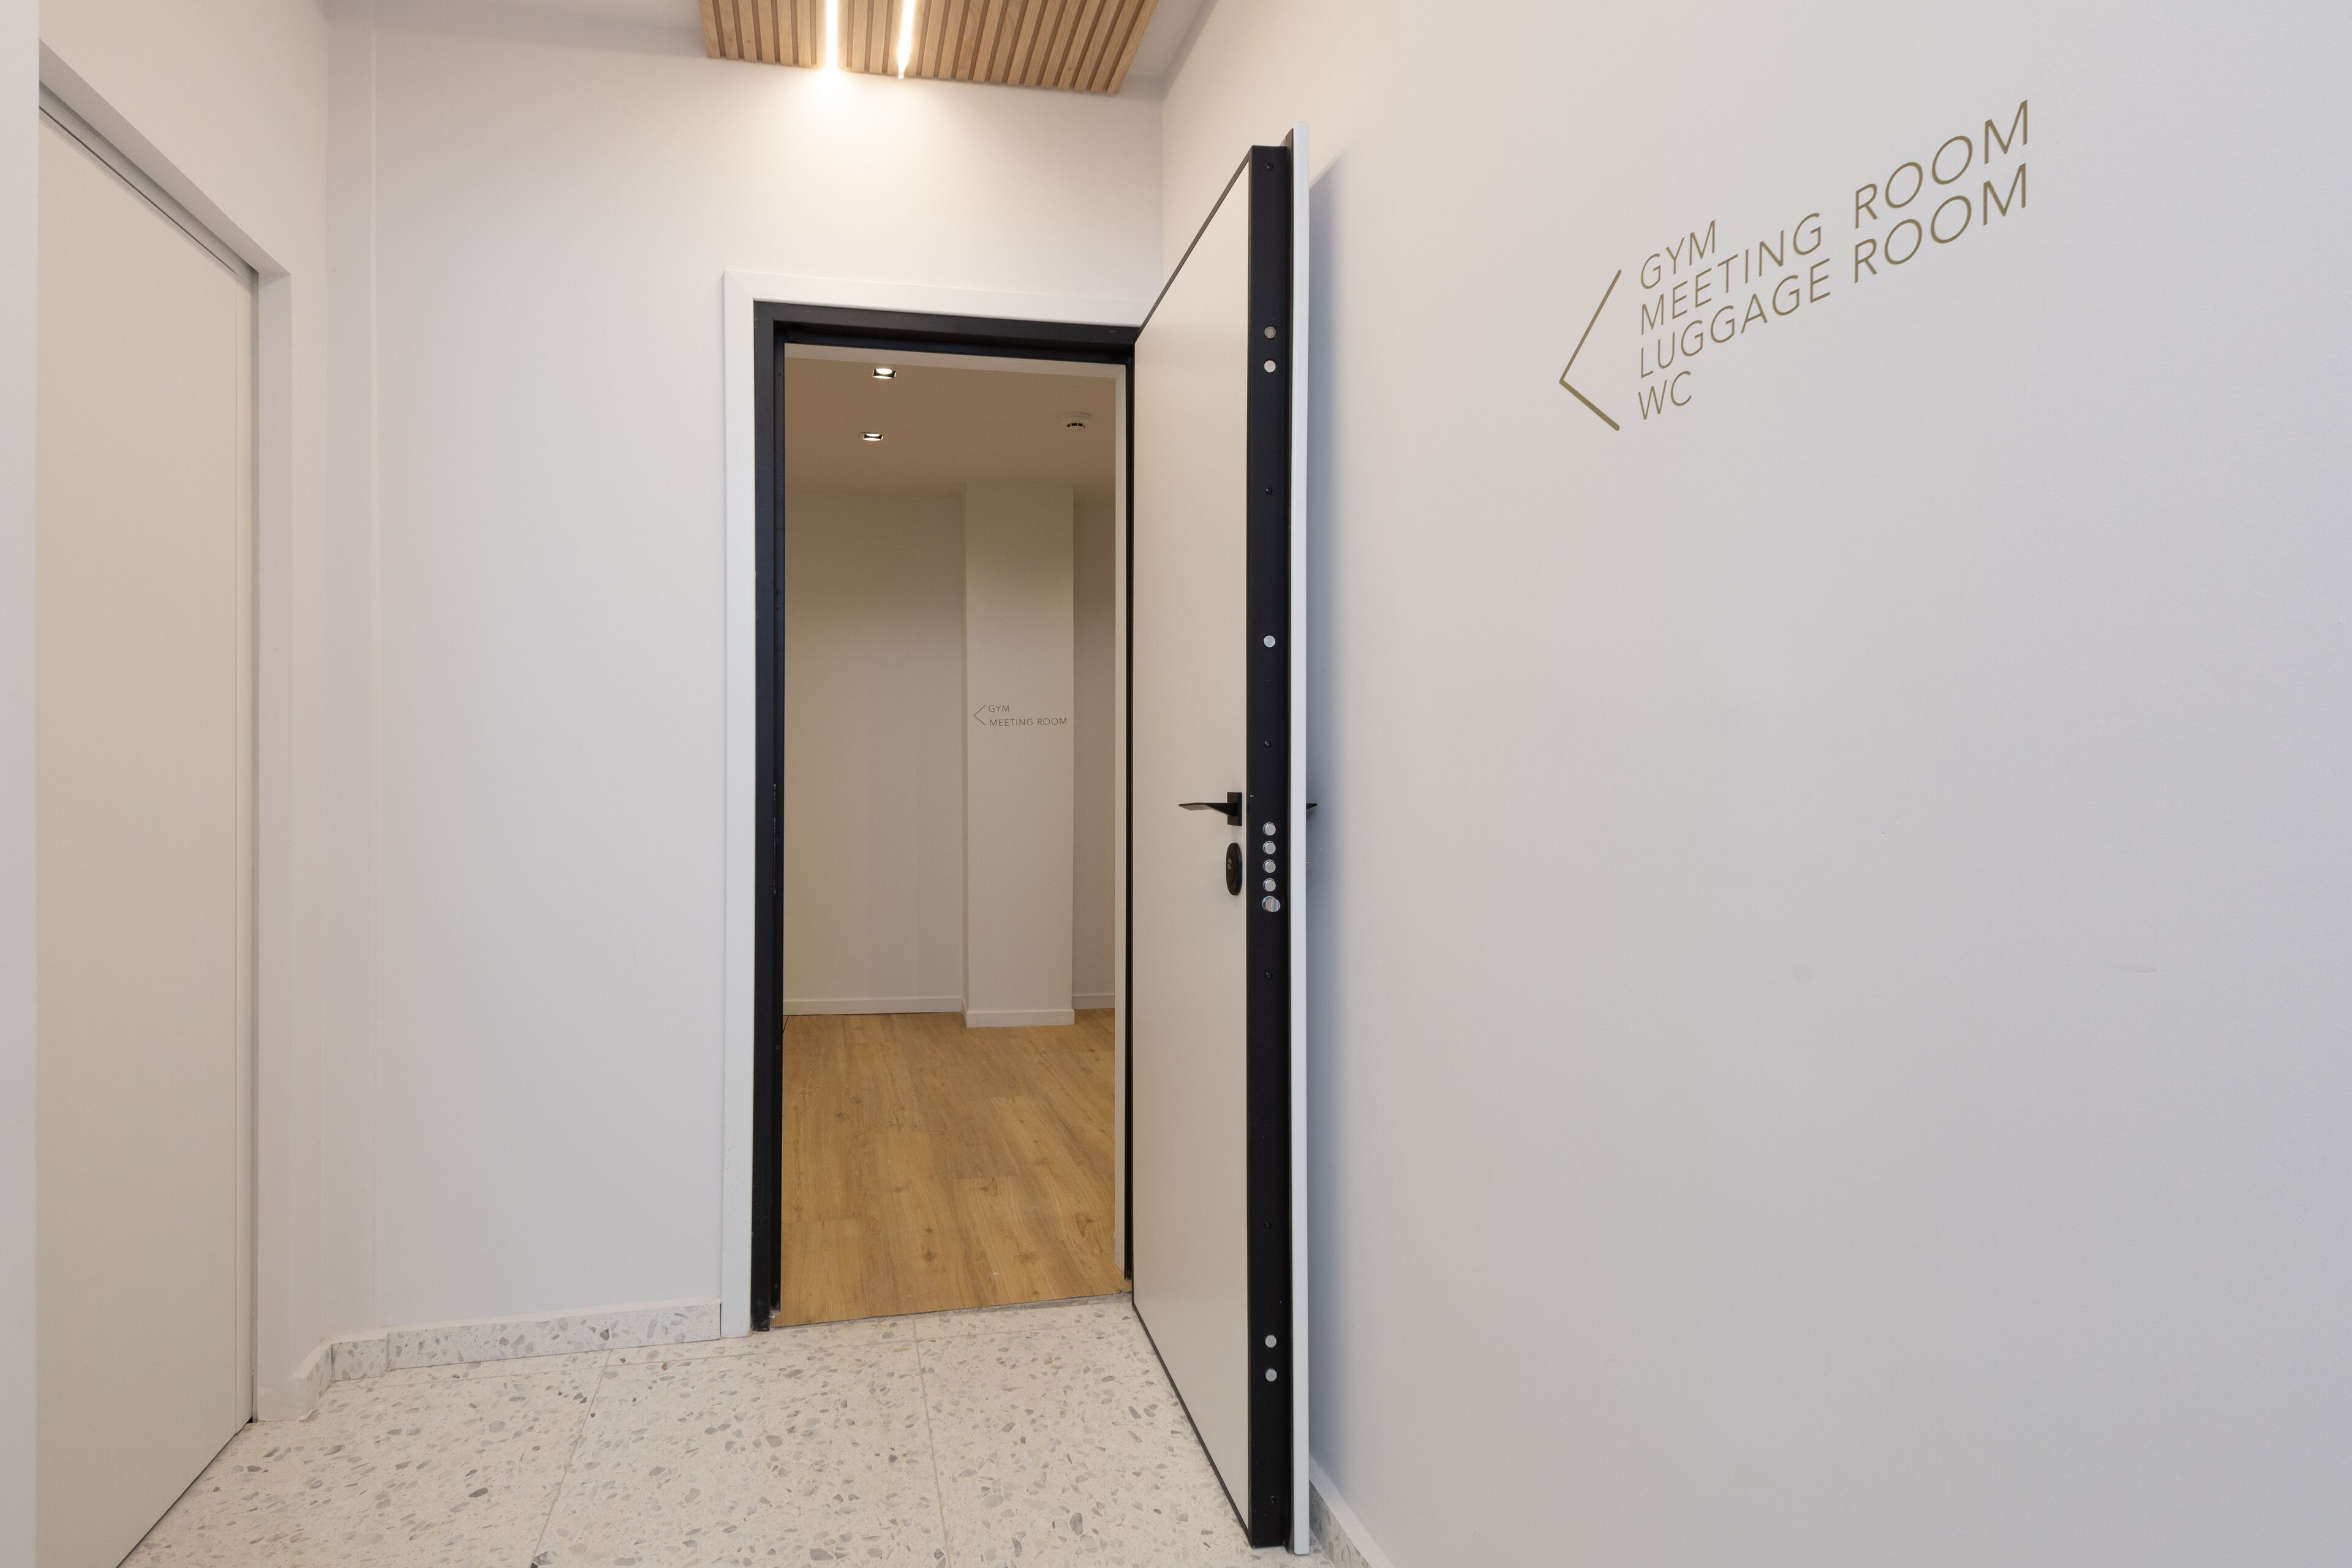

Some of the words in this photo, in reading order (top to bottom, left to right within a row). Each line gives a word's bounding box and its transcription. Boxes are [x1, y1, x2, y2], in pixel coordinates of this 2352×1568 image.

[1640, 213, 1822, 336] MEETING
[1855, 99, 2028, 229] ROOM
[1640, 219, 1716, 290] GYM
[1640, 257, 1831, 379] LUGGAGE
[1854, 162, 2027, 284] ROOM
[1637, 371, 1692, 421] WC
[1037, 717, 1067, 726] ROOM
